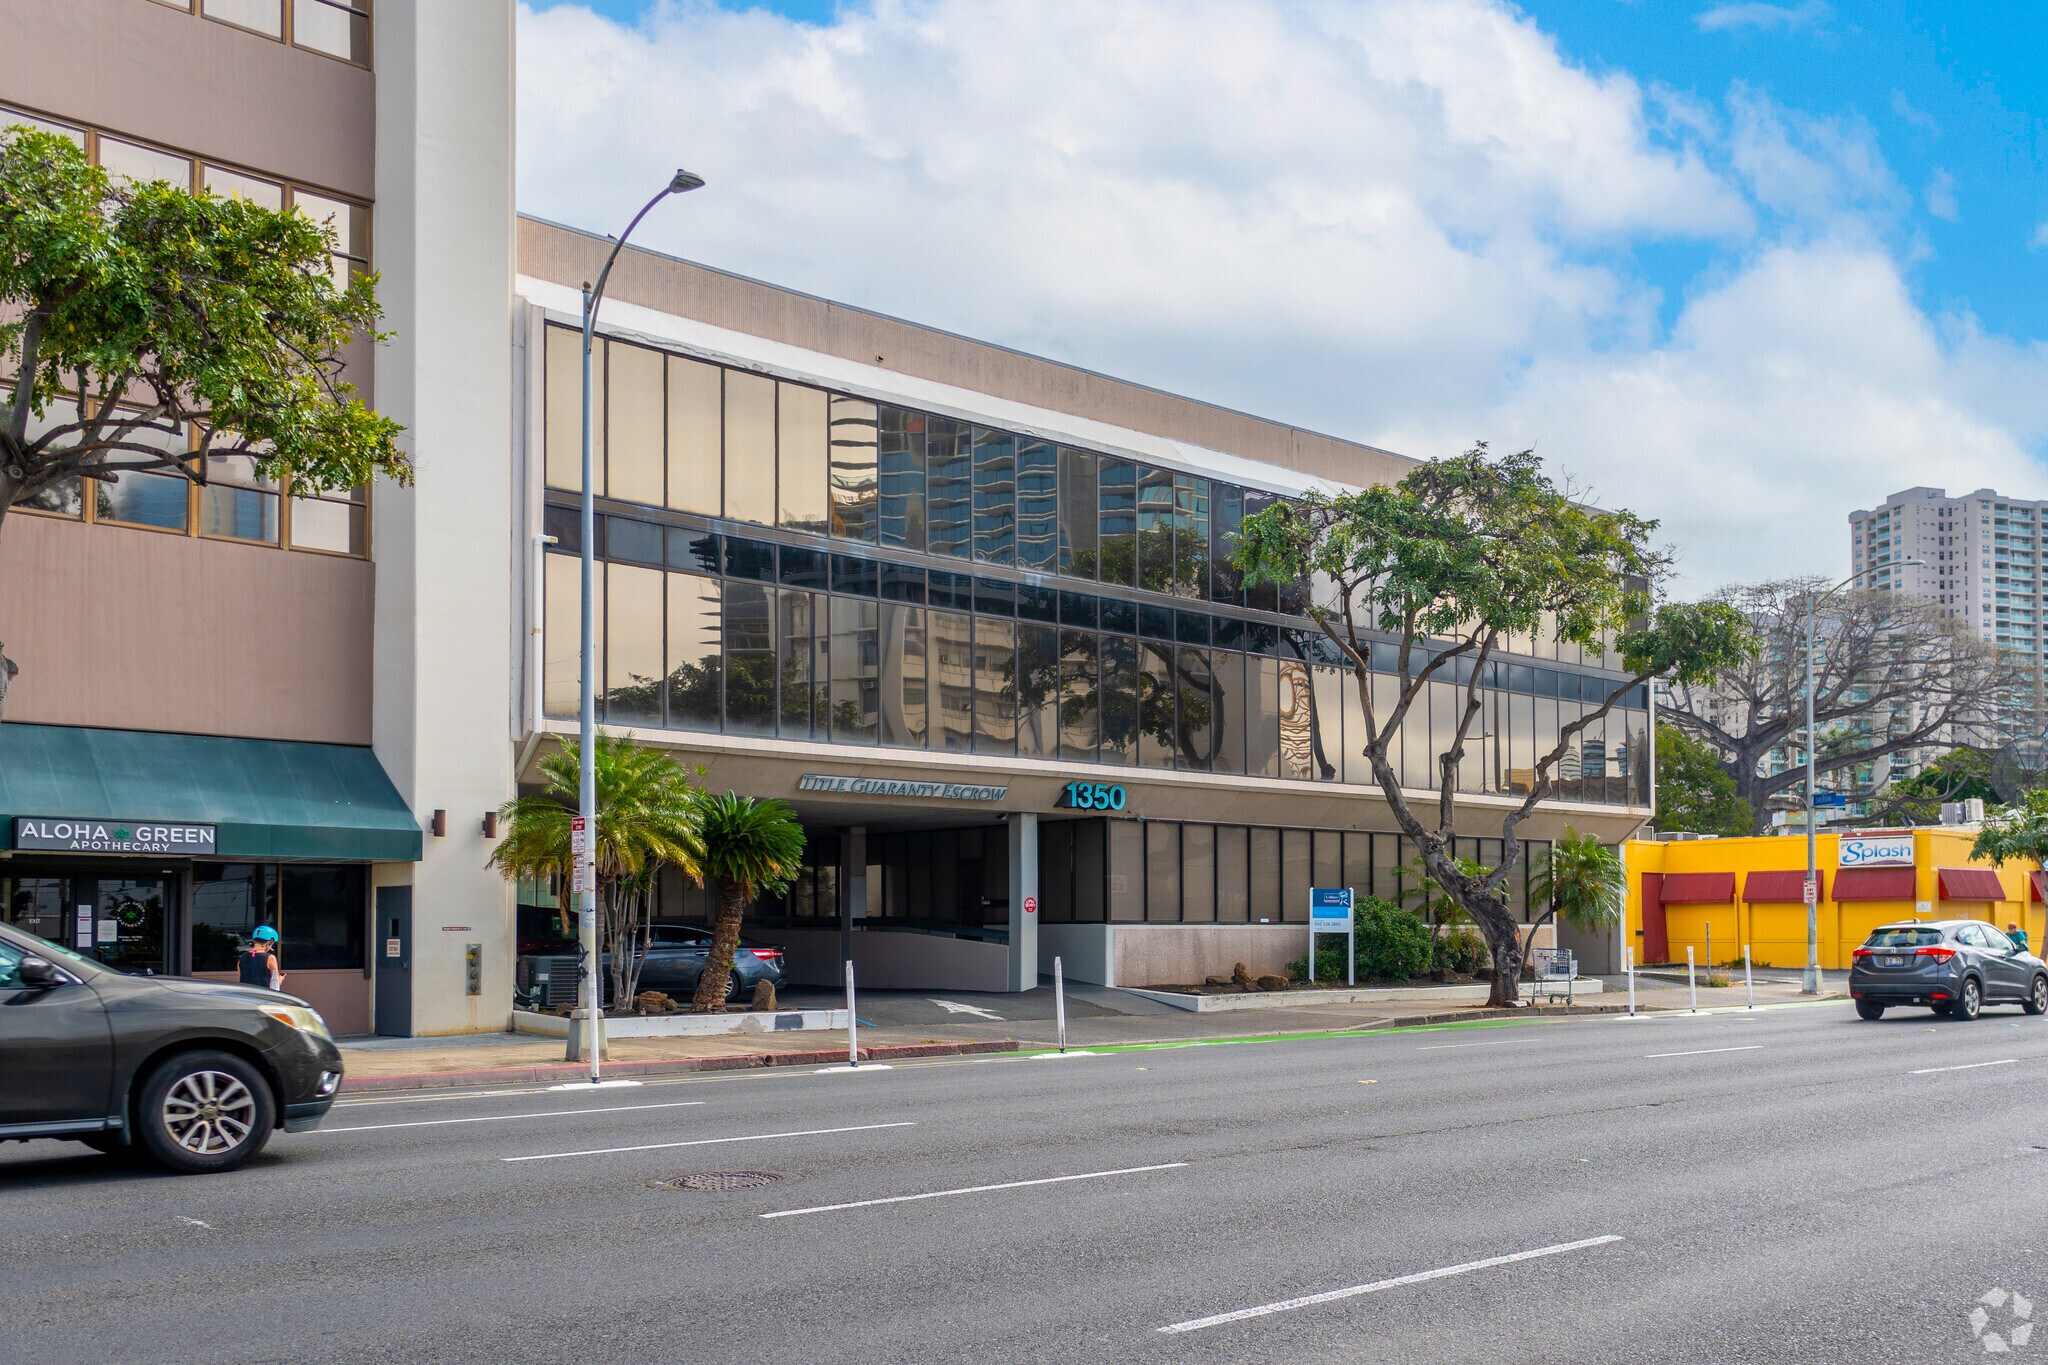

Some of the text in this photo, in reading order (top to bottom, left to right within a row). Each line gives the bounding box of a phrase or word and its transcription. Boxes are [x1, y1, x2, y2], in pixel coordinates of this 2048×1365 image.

[803, 775, 1007, 800] TITLE GUARANTY ESCROW
[1067, 781, 1126, 810] 1350
[21, 822, 214, 844] ALOHA GREEN
[70, 840, 170, 852] APOTHECARY
[1842, 842, 1911, 863] Splash
